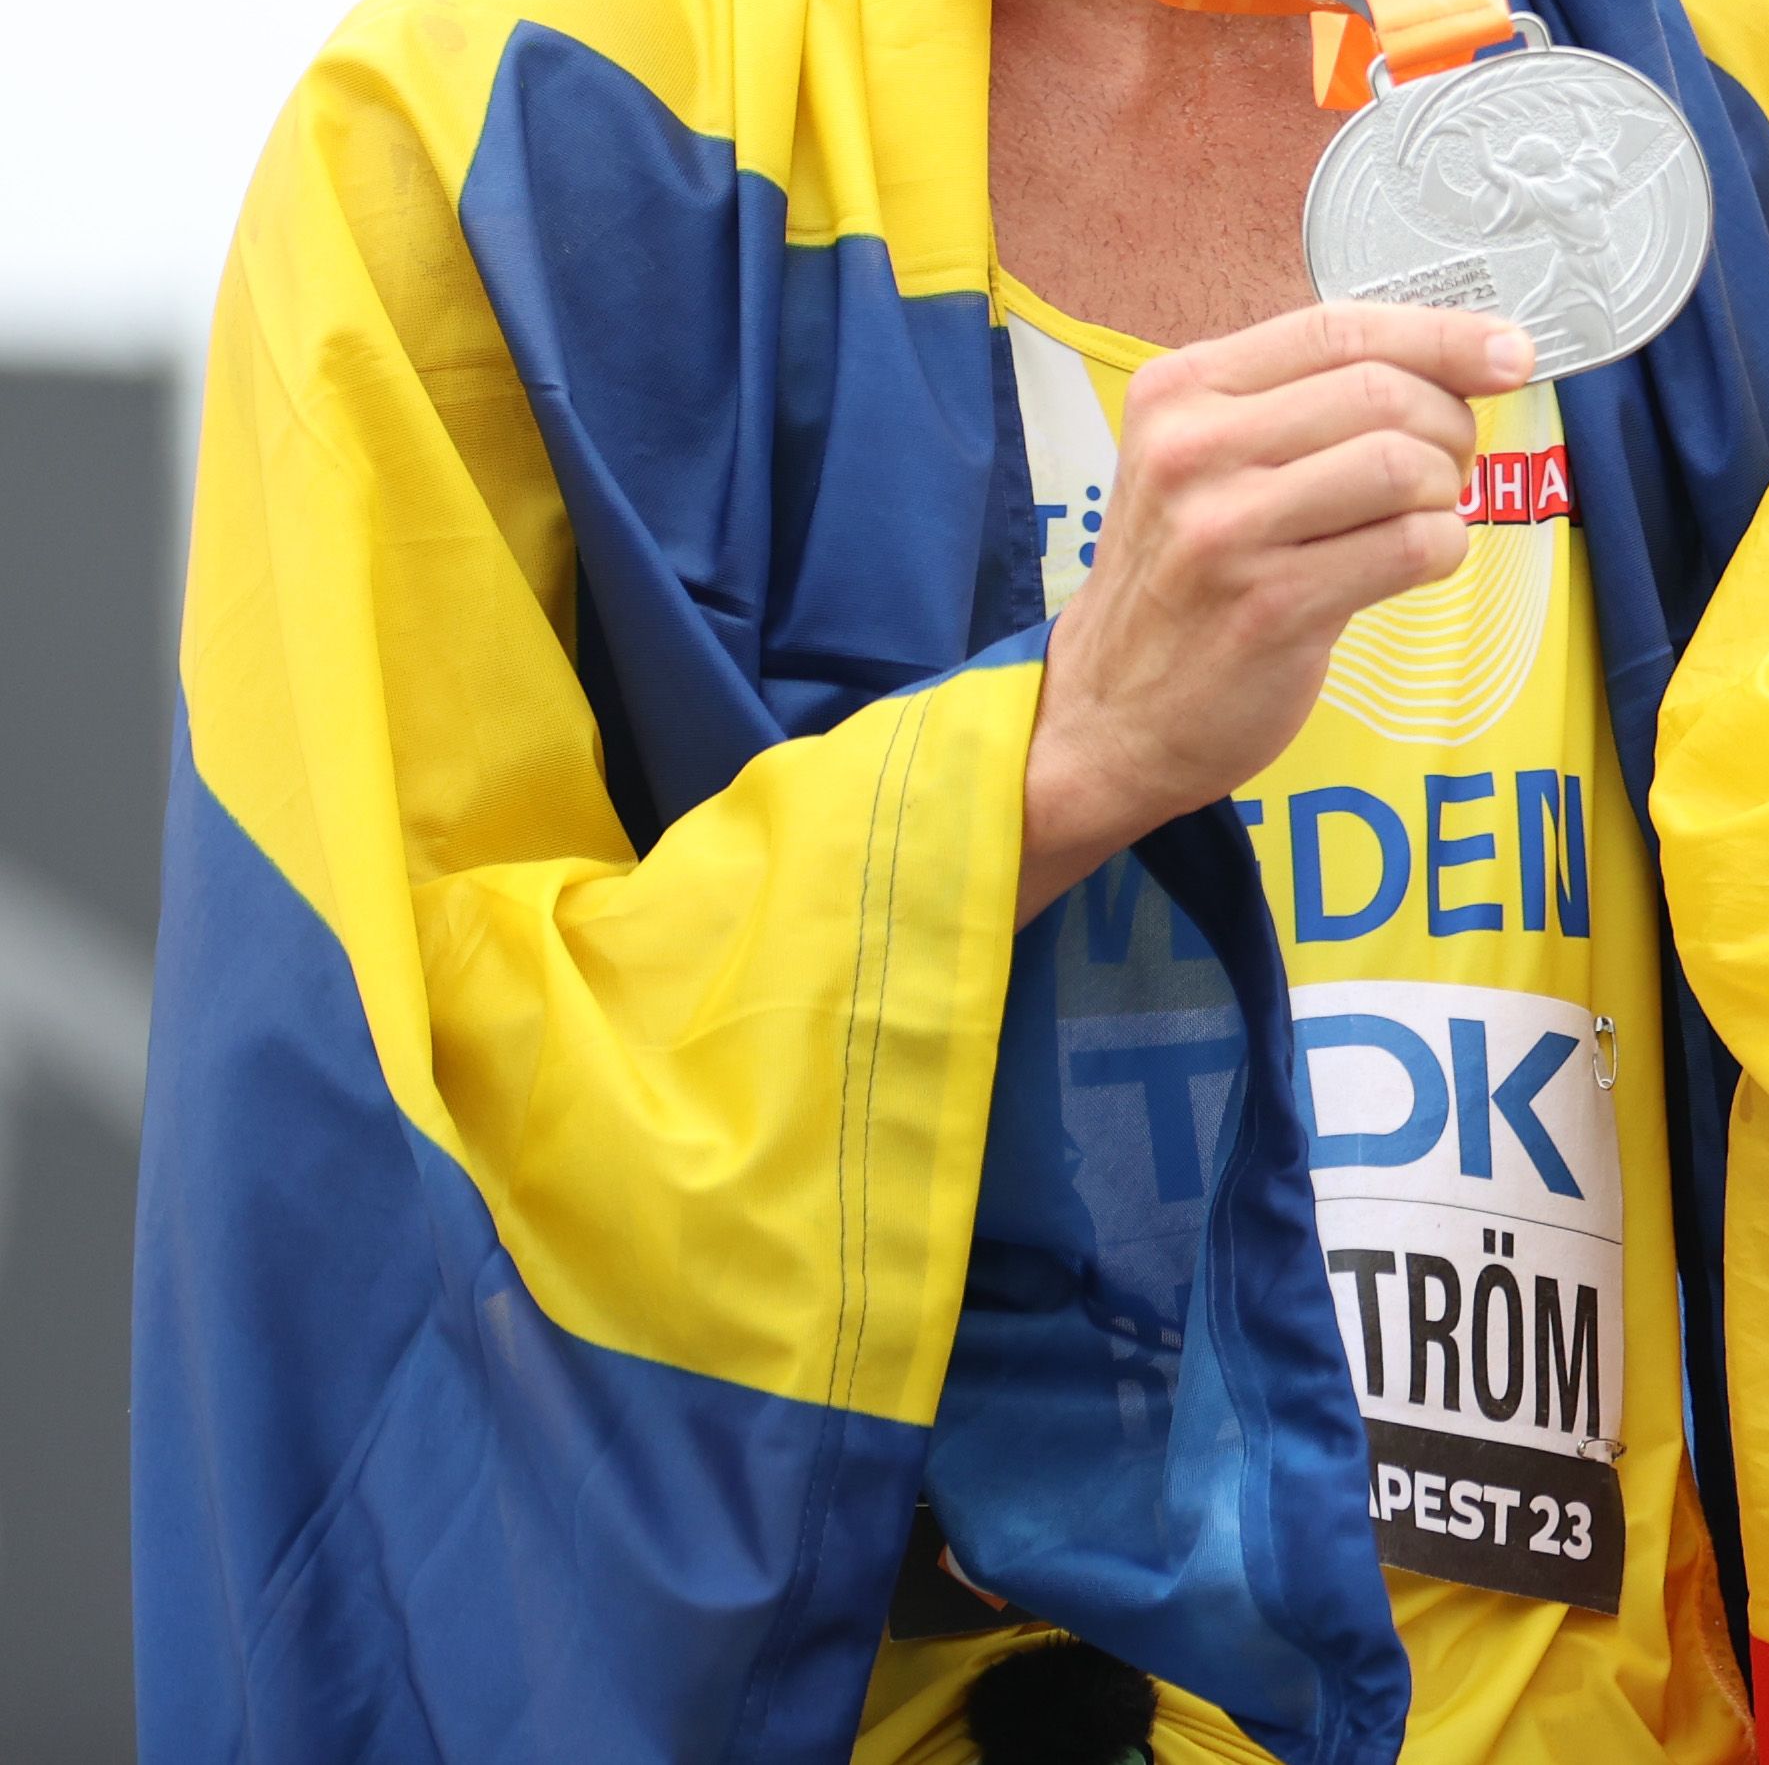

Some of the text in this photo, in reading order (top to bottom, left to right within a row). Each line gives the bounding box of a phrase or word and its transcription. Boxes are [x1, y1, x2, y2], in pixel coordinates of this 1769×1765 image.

[1381, 268, 1492, 304] AMPIONSHIPS
[1327, 1227, 1600, 1438] TRÖM
[1529, 1494, 1593, 1561] 23
